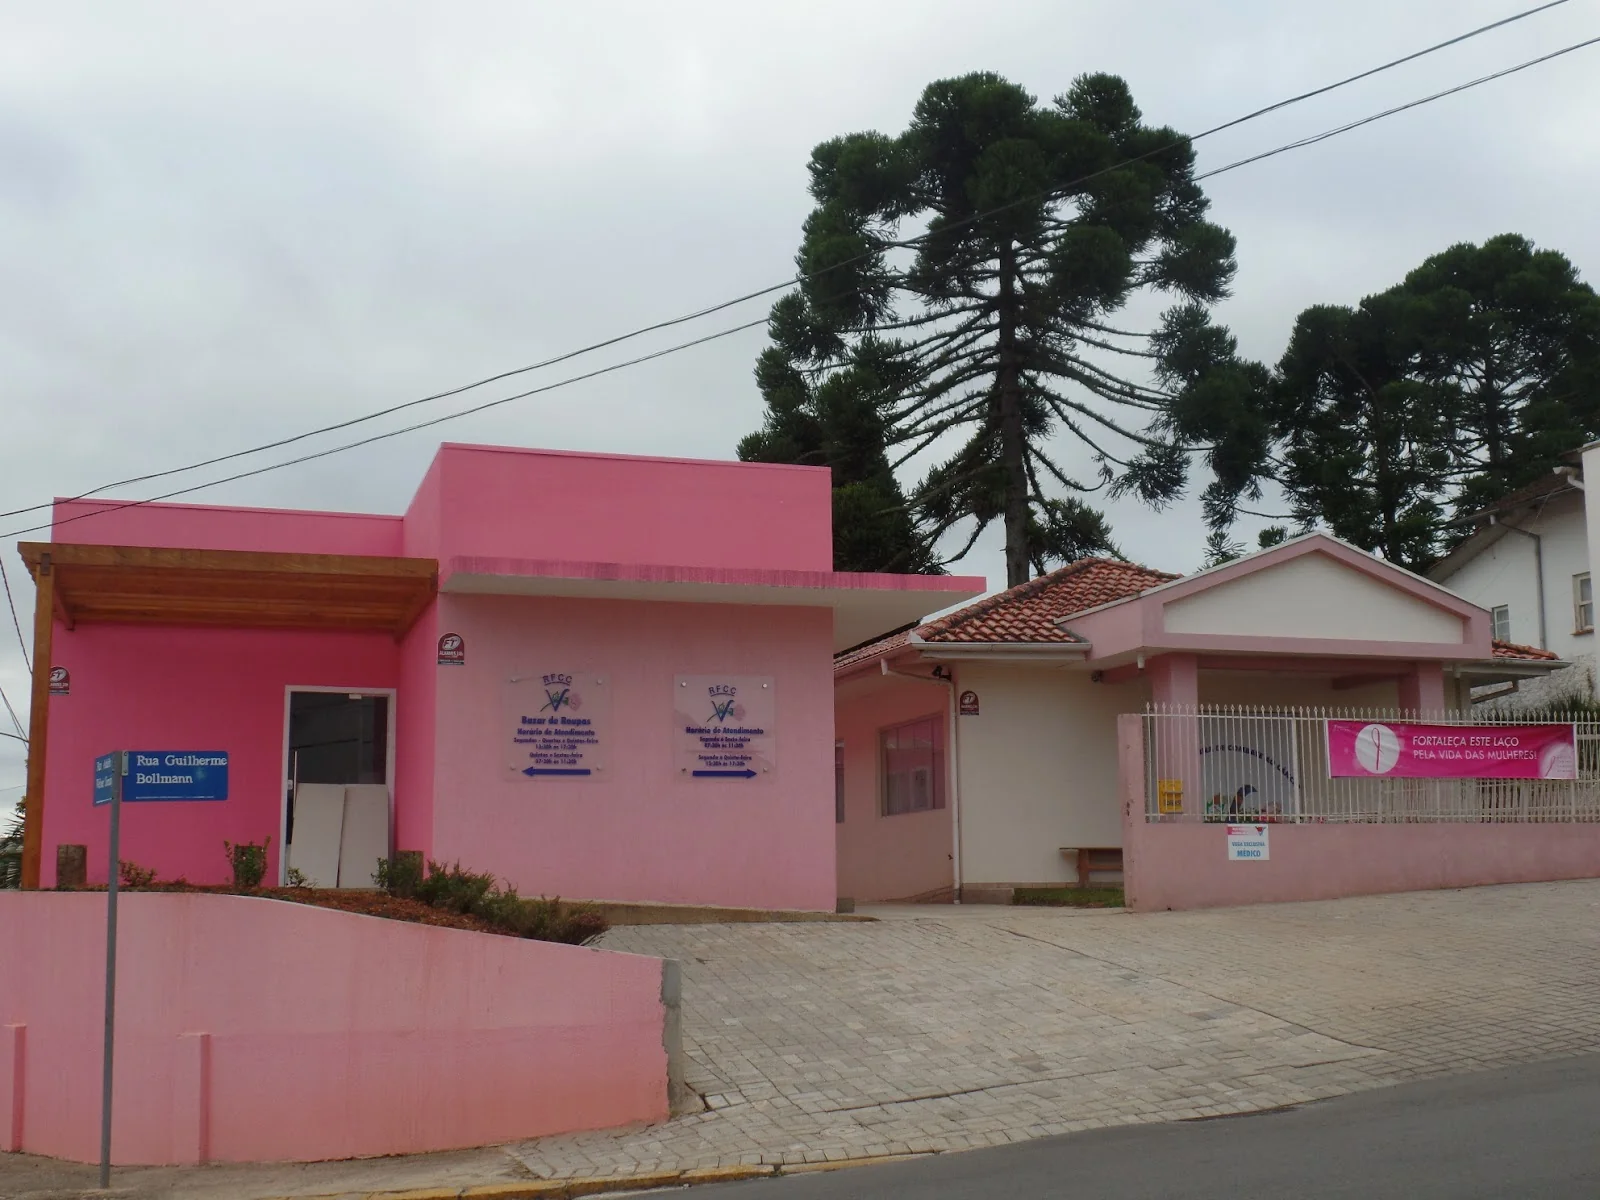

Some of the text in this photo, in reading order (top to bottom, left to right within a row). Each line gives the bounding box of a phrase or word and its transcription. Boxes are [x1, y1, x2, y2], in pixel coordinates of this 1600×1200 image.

[543, 674, 572, 683] RFCC
[709, 685, 737, 695] RFCC
[522, 716, 591, 726] Bazar de Roupas
[554, 728, 595, 736] Atendimento
[686, 726, 764, 734] Horário de Atendimento
[1412, 736, 1519, 748] FORTALEÇA ESTE LAÇO
[1413, 750, 1537, 760] PELA VIDA DAS MULHERES!
[137, 755, 227, 766] Rua Guilherme
[136, 773, 193, 784] Bollmann
